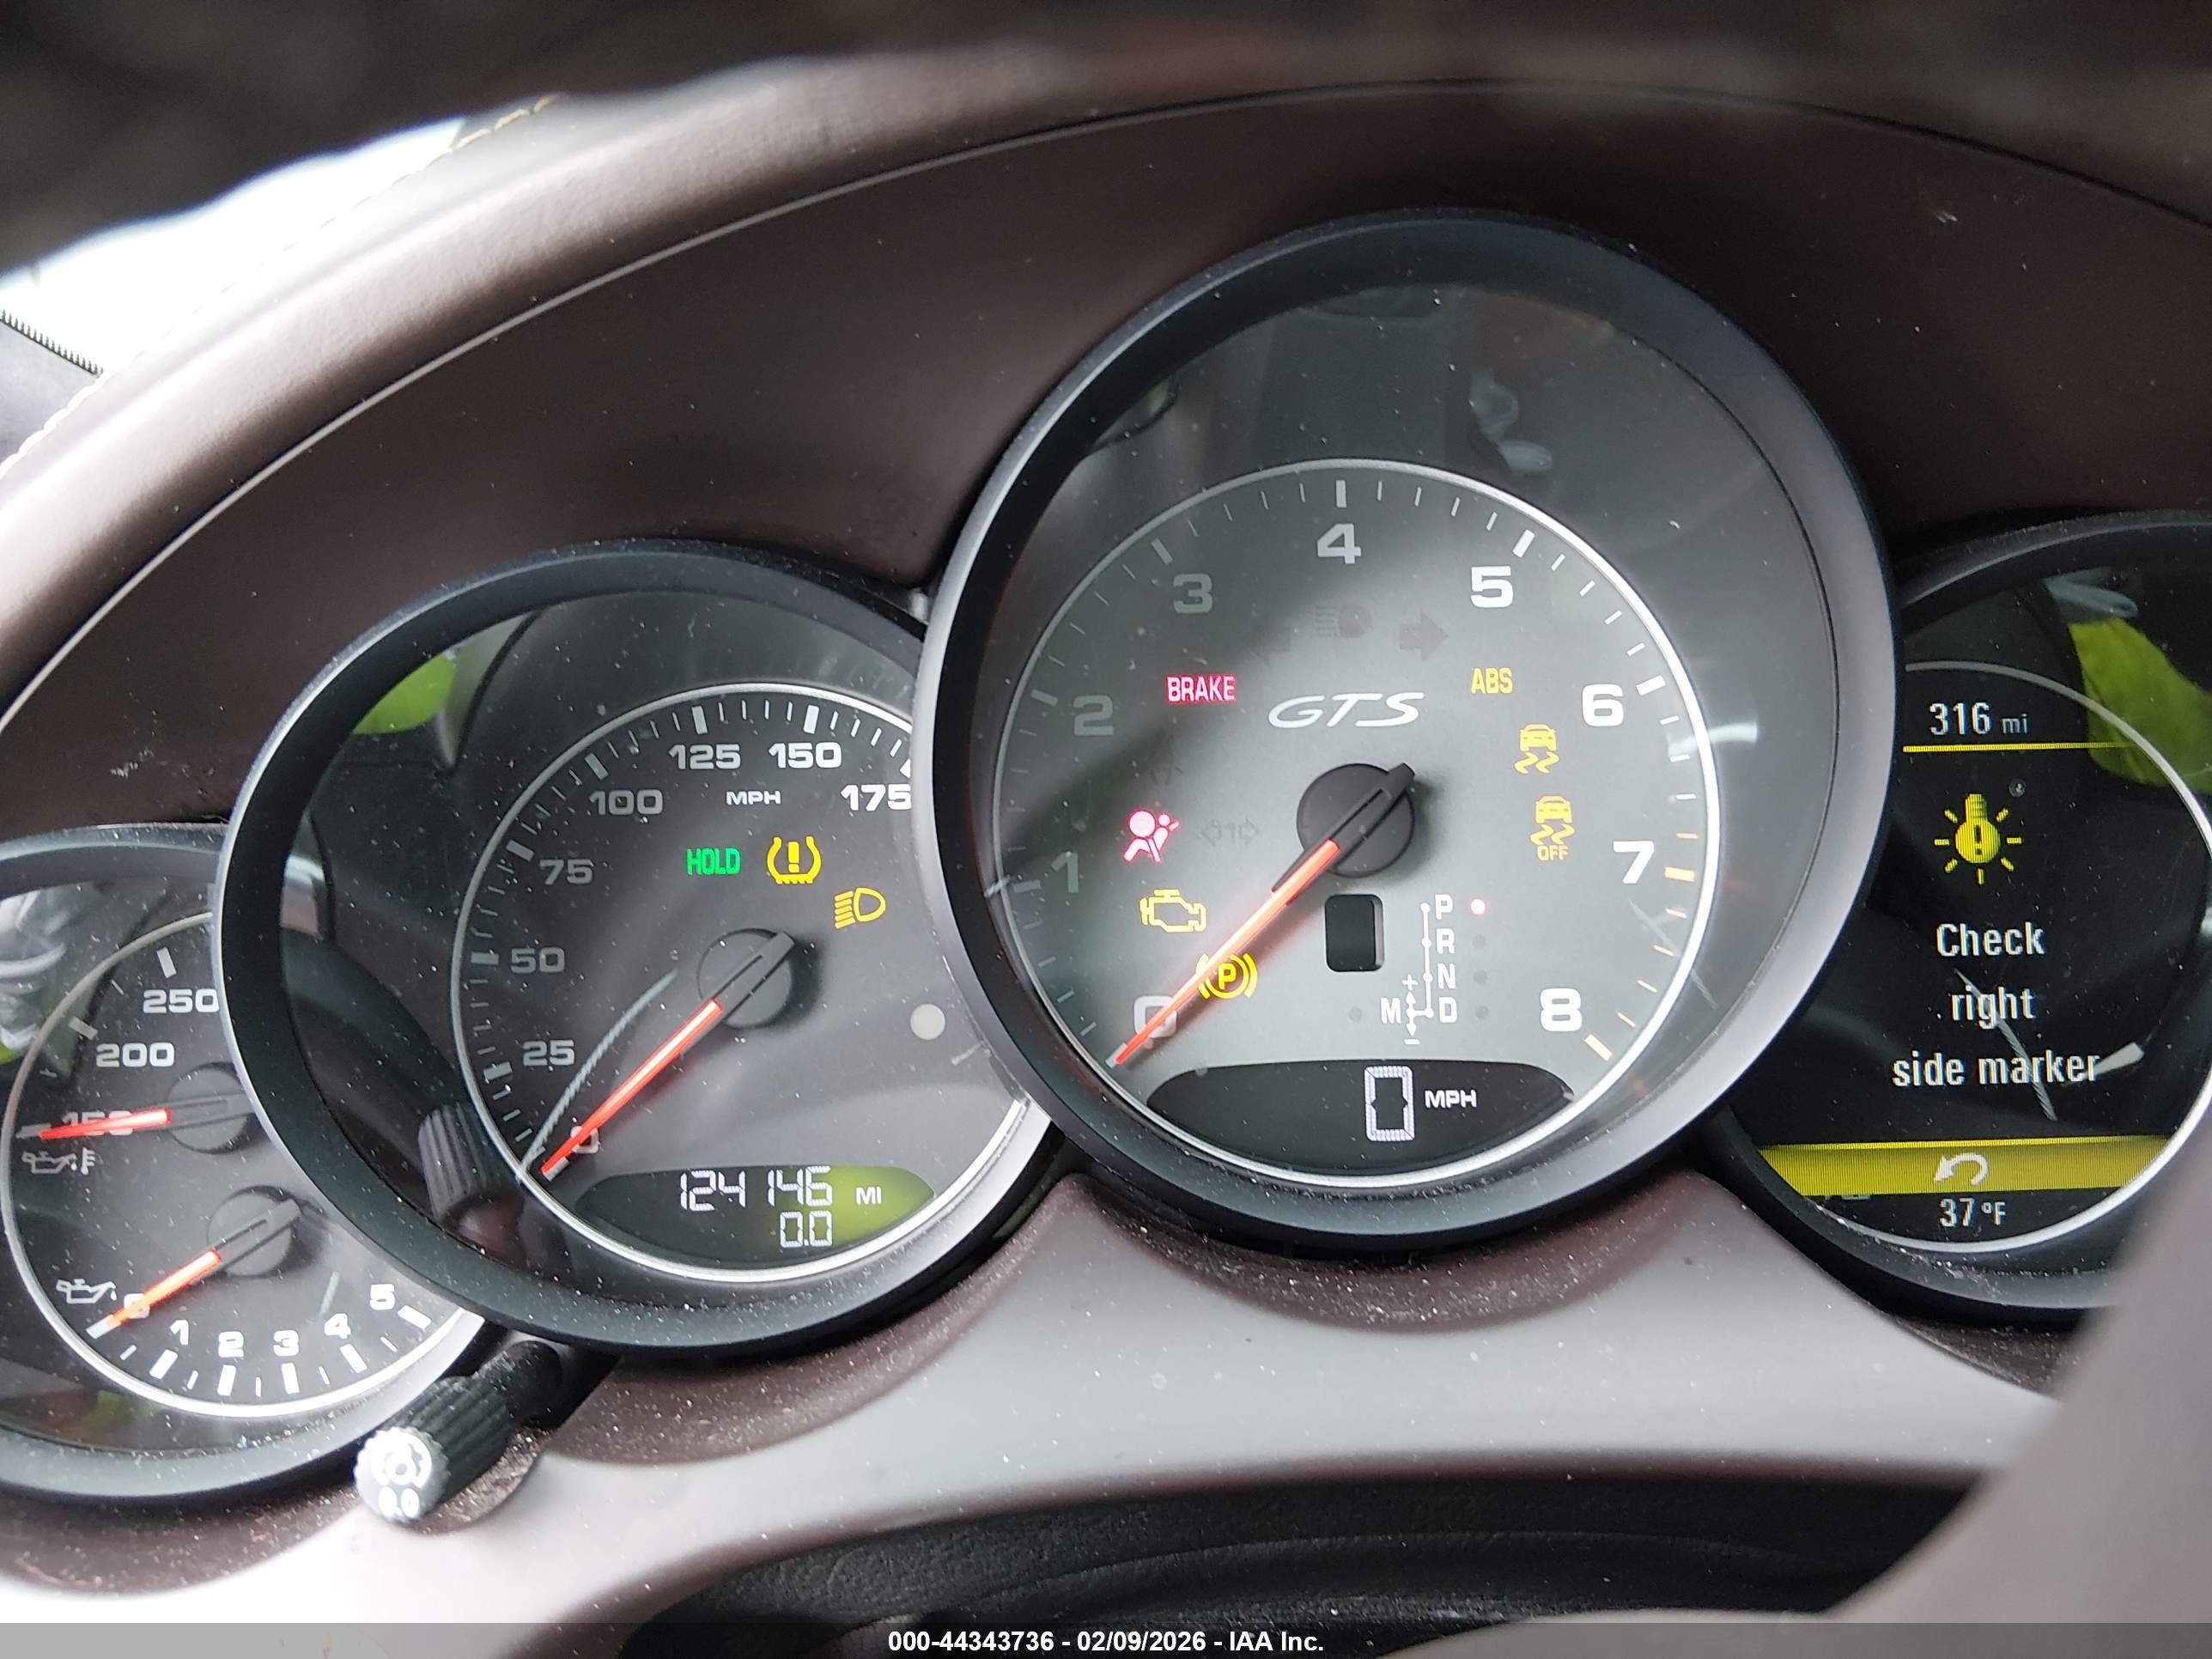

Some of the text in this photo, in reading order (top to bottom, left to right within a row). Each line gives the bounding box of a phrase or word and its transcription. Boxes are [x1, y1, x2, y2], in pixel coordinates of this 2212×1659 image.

[1316, 524, 1361, 564] 4
[1173, 573, 1213, 614] 3
[1471, 566, 1514, 609] 5
[1167, 675, 1237, 703] BRAKE
[1471, 666, 1514, 695] ABS
[1073, 695, 1115, 736] 2
[1269, 692, 1425, 729] GTS
[1583, 684, 1624, 726] 6
[1929, 702, 2029, 736] 316 mi
[669, 744, 741, 770] 125
[769, 742, 842, 769] 150
[590, 789, 664, 816] 100
[726, 791, 781, 805] MPH
[842, 783, 912, 811] 175
[687, 848, 740, 876] HOLD
[1536, 845, 1569, 861] OFF
[1613, 841, 1655, 884] 7
[539, 860, 593, 884] 75
[1050, 852, 1079, 893] 1
[1434, 894, 1454, 920] P
[1436, 928, 1455, 954] R
[1936, 921, 2045, 957] Check
[510, 947, 566, 974] 50
[1218, 963, 1237, 990] P
[1437, 963, 1457, 989] N
[143, 990, 220, 1013] 250
[1380, 997, 1401, 1024] M
[1438, 996, 1458, 1023] D
[1540, 988, 1583, 1032] 8
[1952, 986, 2034, 1030] right
[1133, 995, 1177, 1039] 0
[96, 1042, 175, 1067] 200
[522, 1040, 575, 1066] 25
[1892, 1049, 2104, 1088] side marker
[1364, 1066, 1478, 1141] 0 MPH
[680, 1165, 883, 1212] 124146 MI
[1939, 1198, 1975, 1227] 37
[779, 1210, 833, 1248] 0.0
[369, 1283, 396, 1310] 5
[170, 1319, 189, 1346] 1
[324, 1312, 351, 1340] 4
[218, 1331, 245, 1358] 2
[273, 1329, 300, 1357] 3
